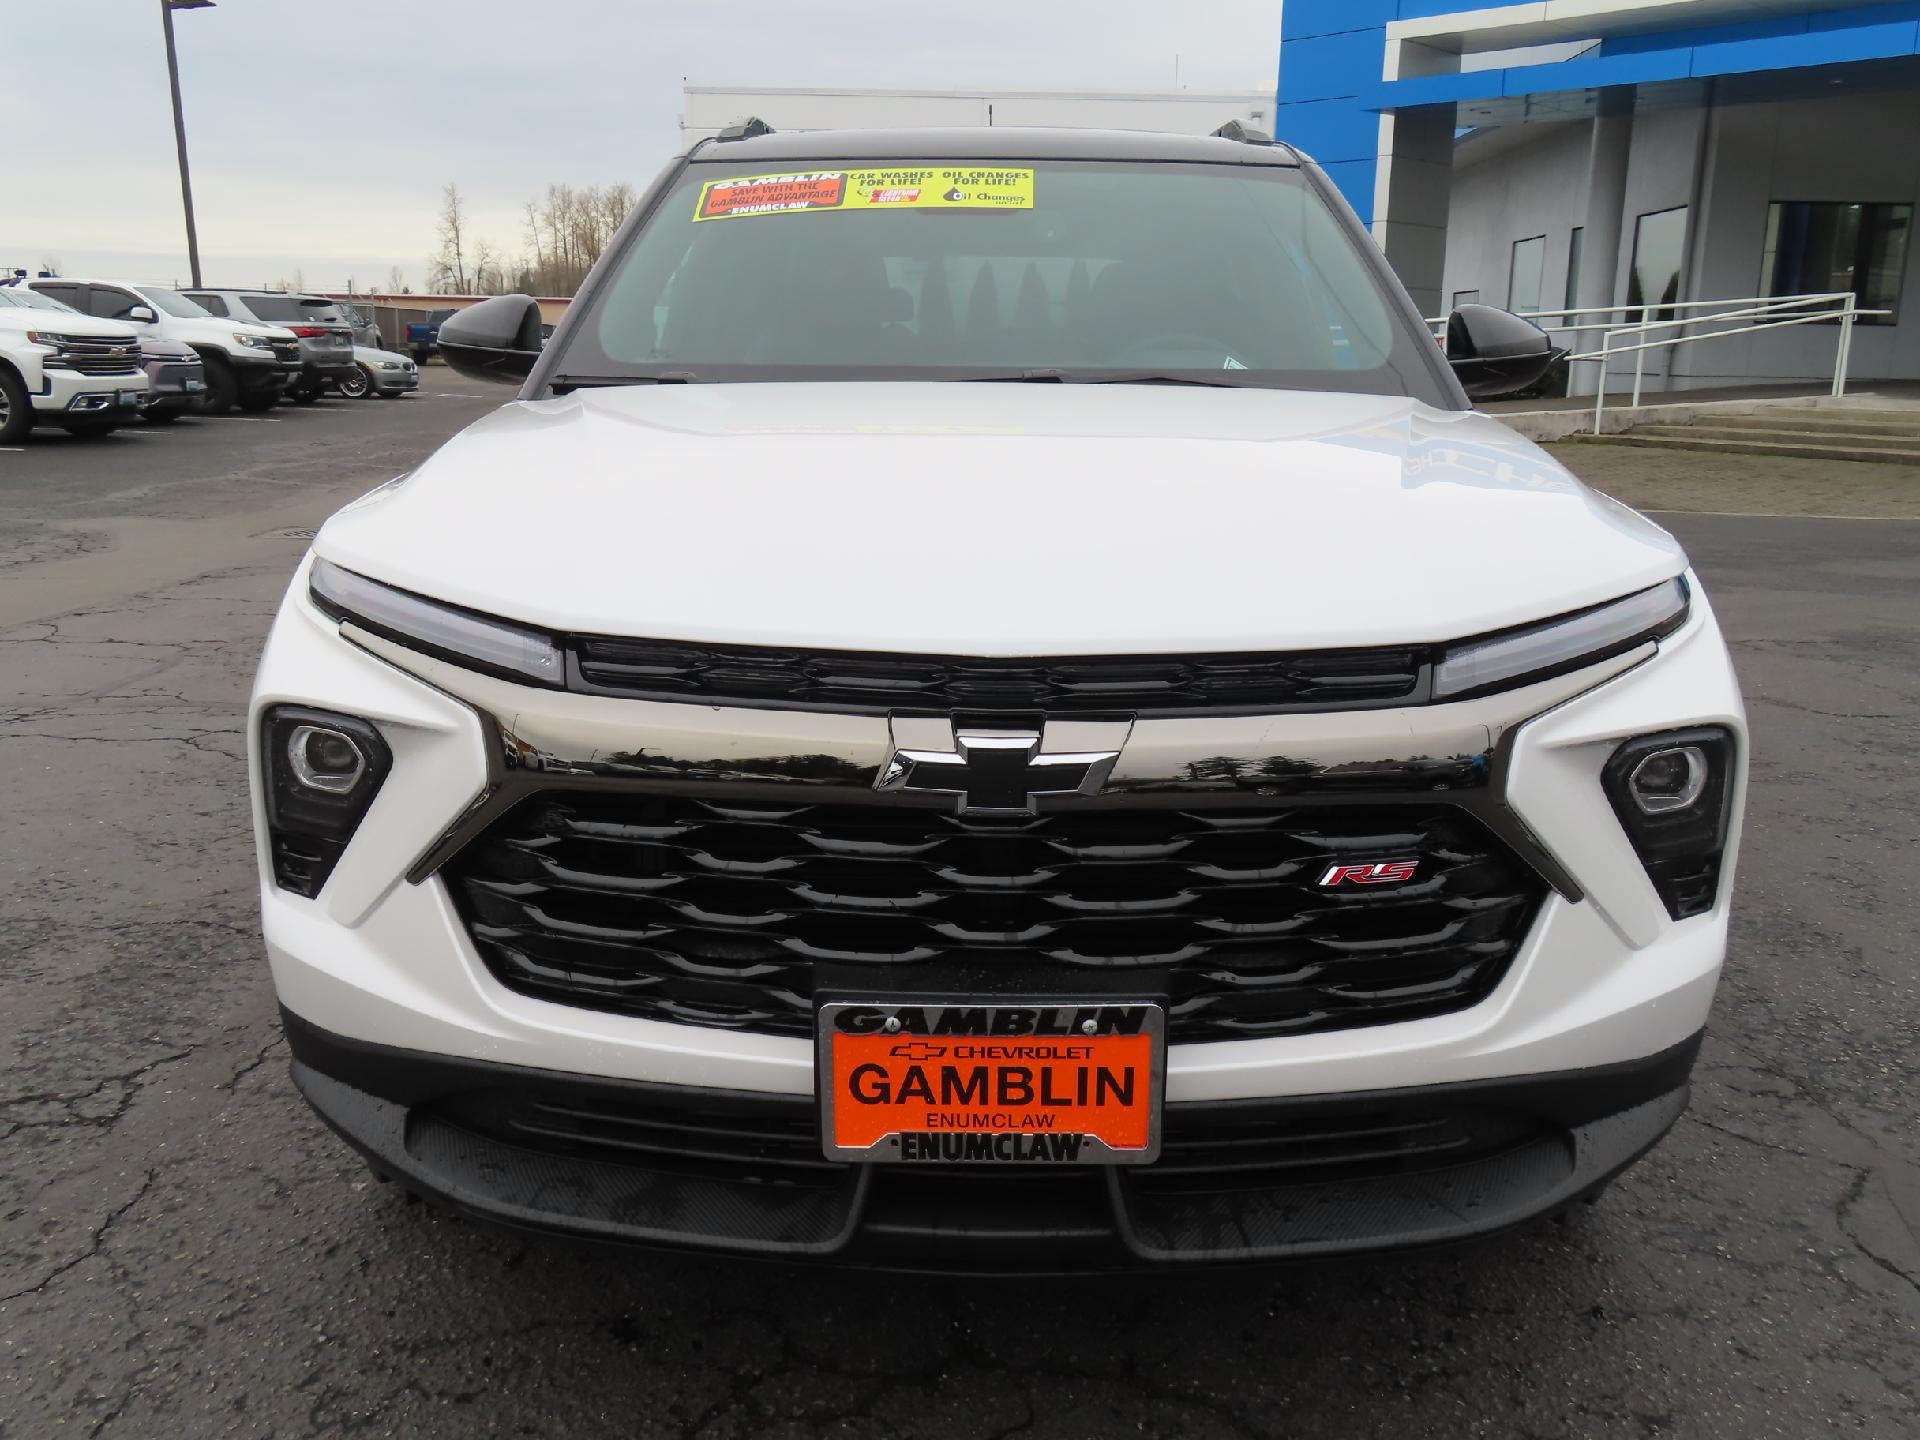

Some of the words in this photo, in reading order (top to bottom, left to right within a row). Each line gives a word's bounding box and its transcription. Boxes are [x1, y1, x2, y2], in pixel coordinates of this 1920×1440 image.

[713, 173, 842, 189] GAMBLIN
[850, 171, 877, 180] CAR
[880, 171, 934, 179] WASHES
[859, 178, 887, 187] FOR
[890, 178, 922, 186] LIFE!
[942, 171, 965, 179] OIL
[968, 171, 1030, 179] CHANGES
[953, 178, 981, 186] FOR
[984, 178, 1017, 186] LIFE!
[731, 187, 759, 197] SAVE
[762, 184, 794, 194] WITH
[797, 182, 819, 190] THE
[710, 195, 765, 208] GAMBLIN
[767, 190, 837, 202] ADVANTAGE
[1319, 861, 1420, 886] RS
[834, 1006, 1150, 1036] GAMBLIN
[953, 1046, 1095, 1060] CHEVROLET
[849, 1063, 1135, 1107] GAMBLIN
[926, 1112, 1056, 1129] ENUMCLAW
